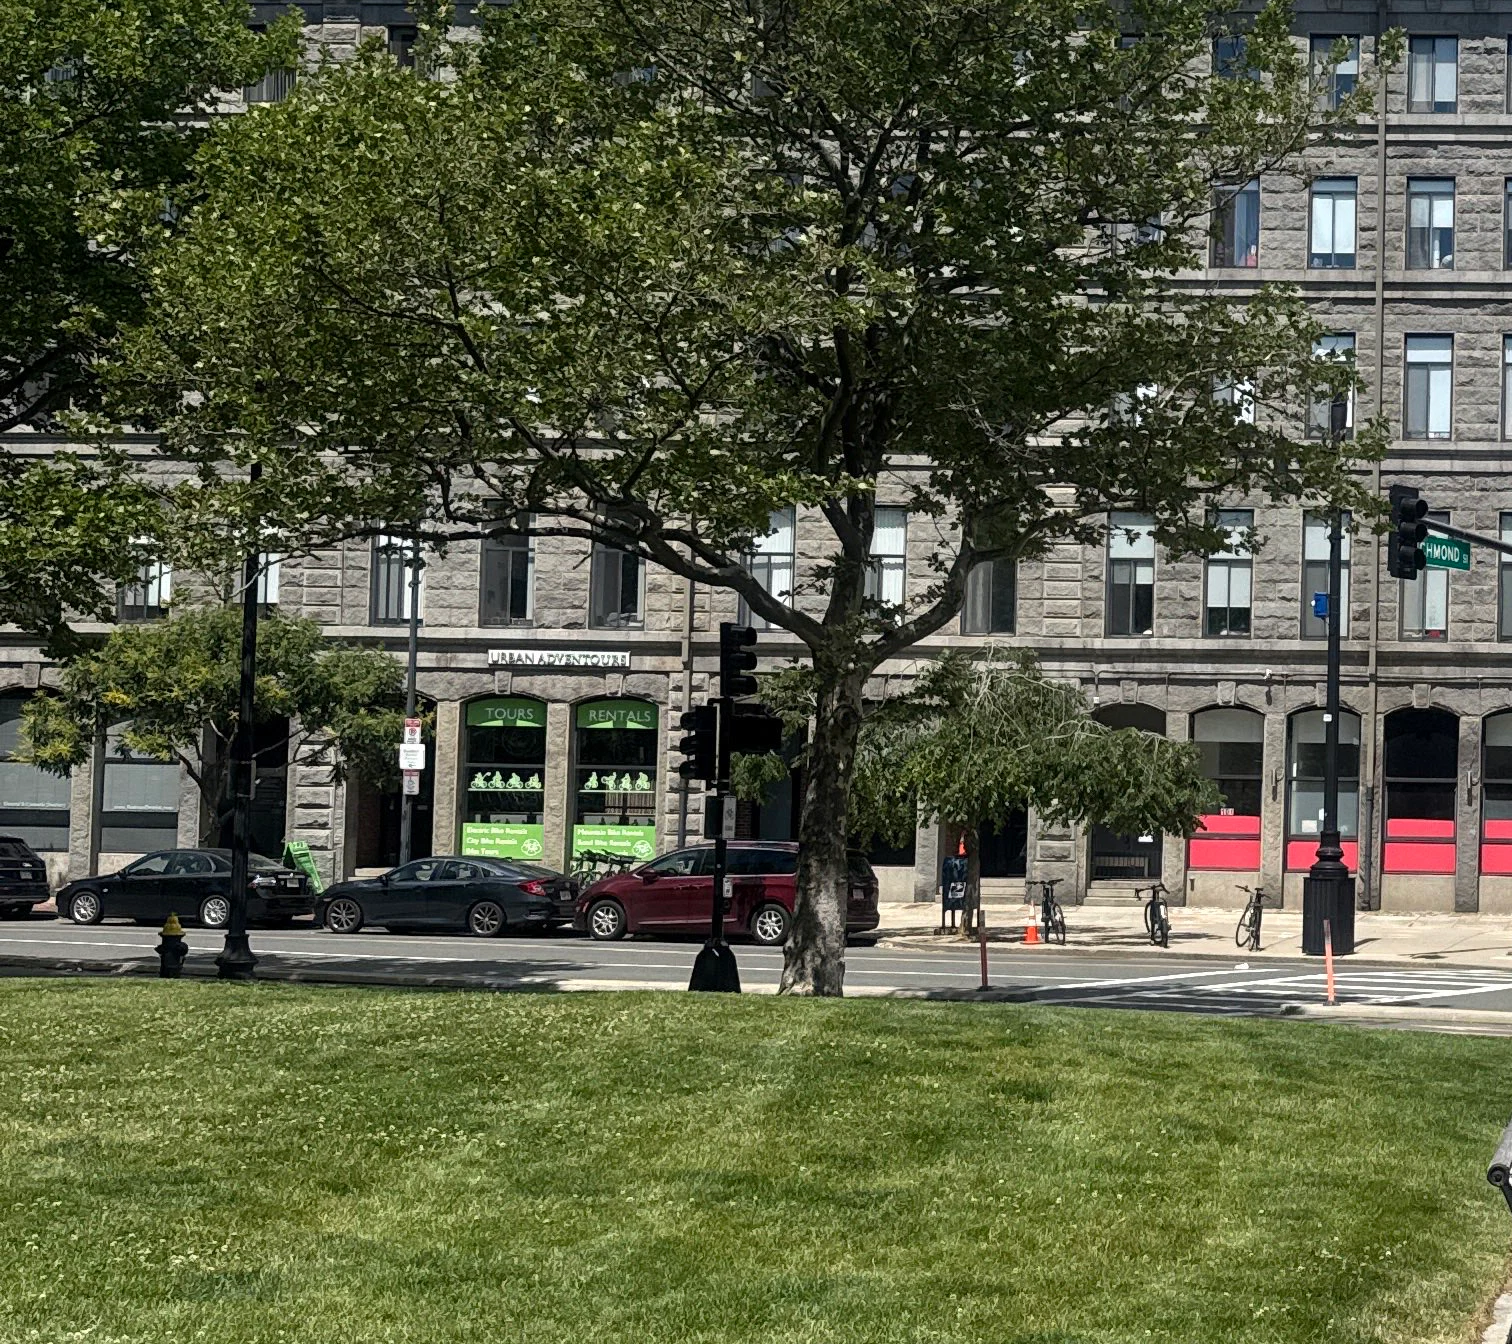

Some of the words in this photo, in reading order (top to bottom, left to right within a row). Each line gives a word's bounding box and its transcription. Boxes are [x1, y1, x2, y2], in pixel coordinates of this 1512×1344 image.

[490, 651, 535, 665] URBAN
[537, 652, 627, 667] ADVENTOURS
[485, 707, 534, 720] TOURS
[588, 709, 651, 722] RENTALS
